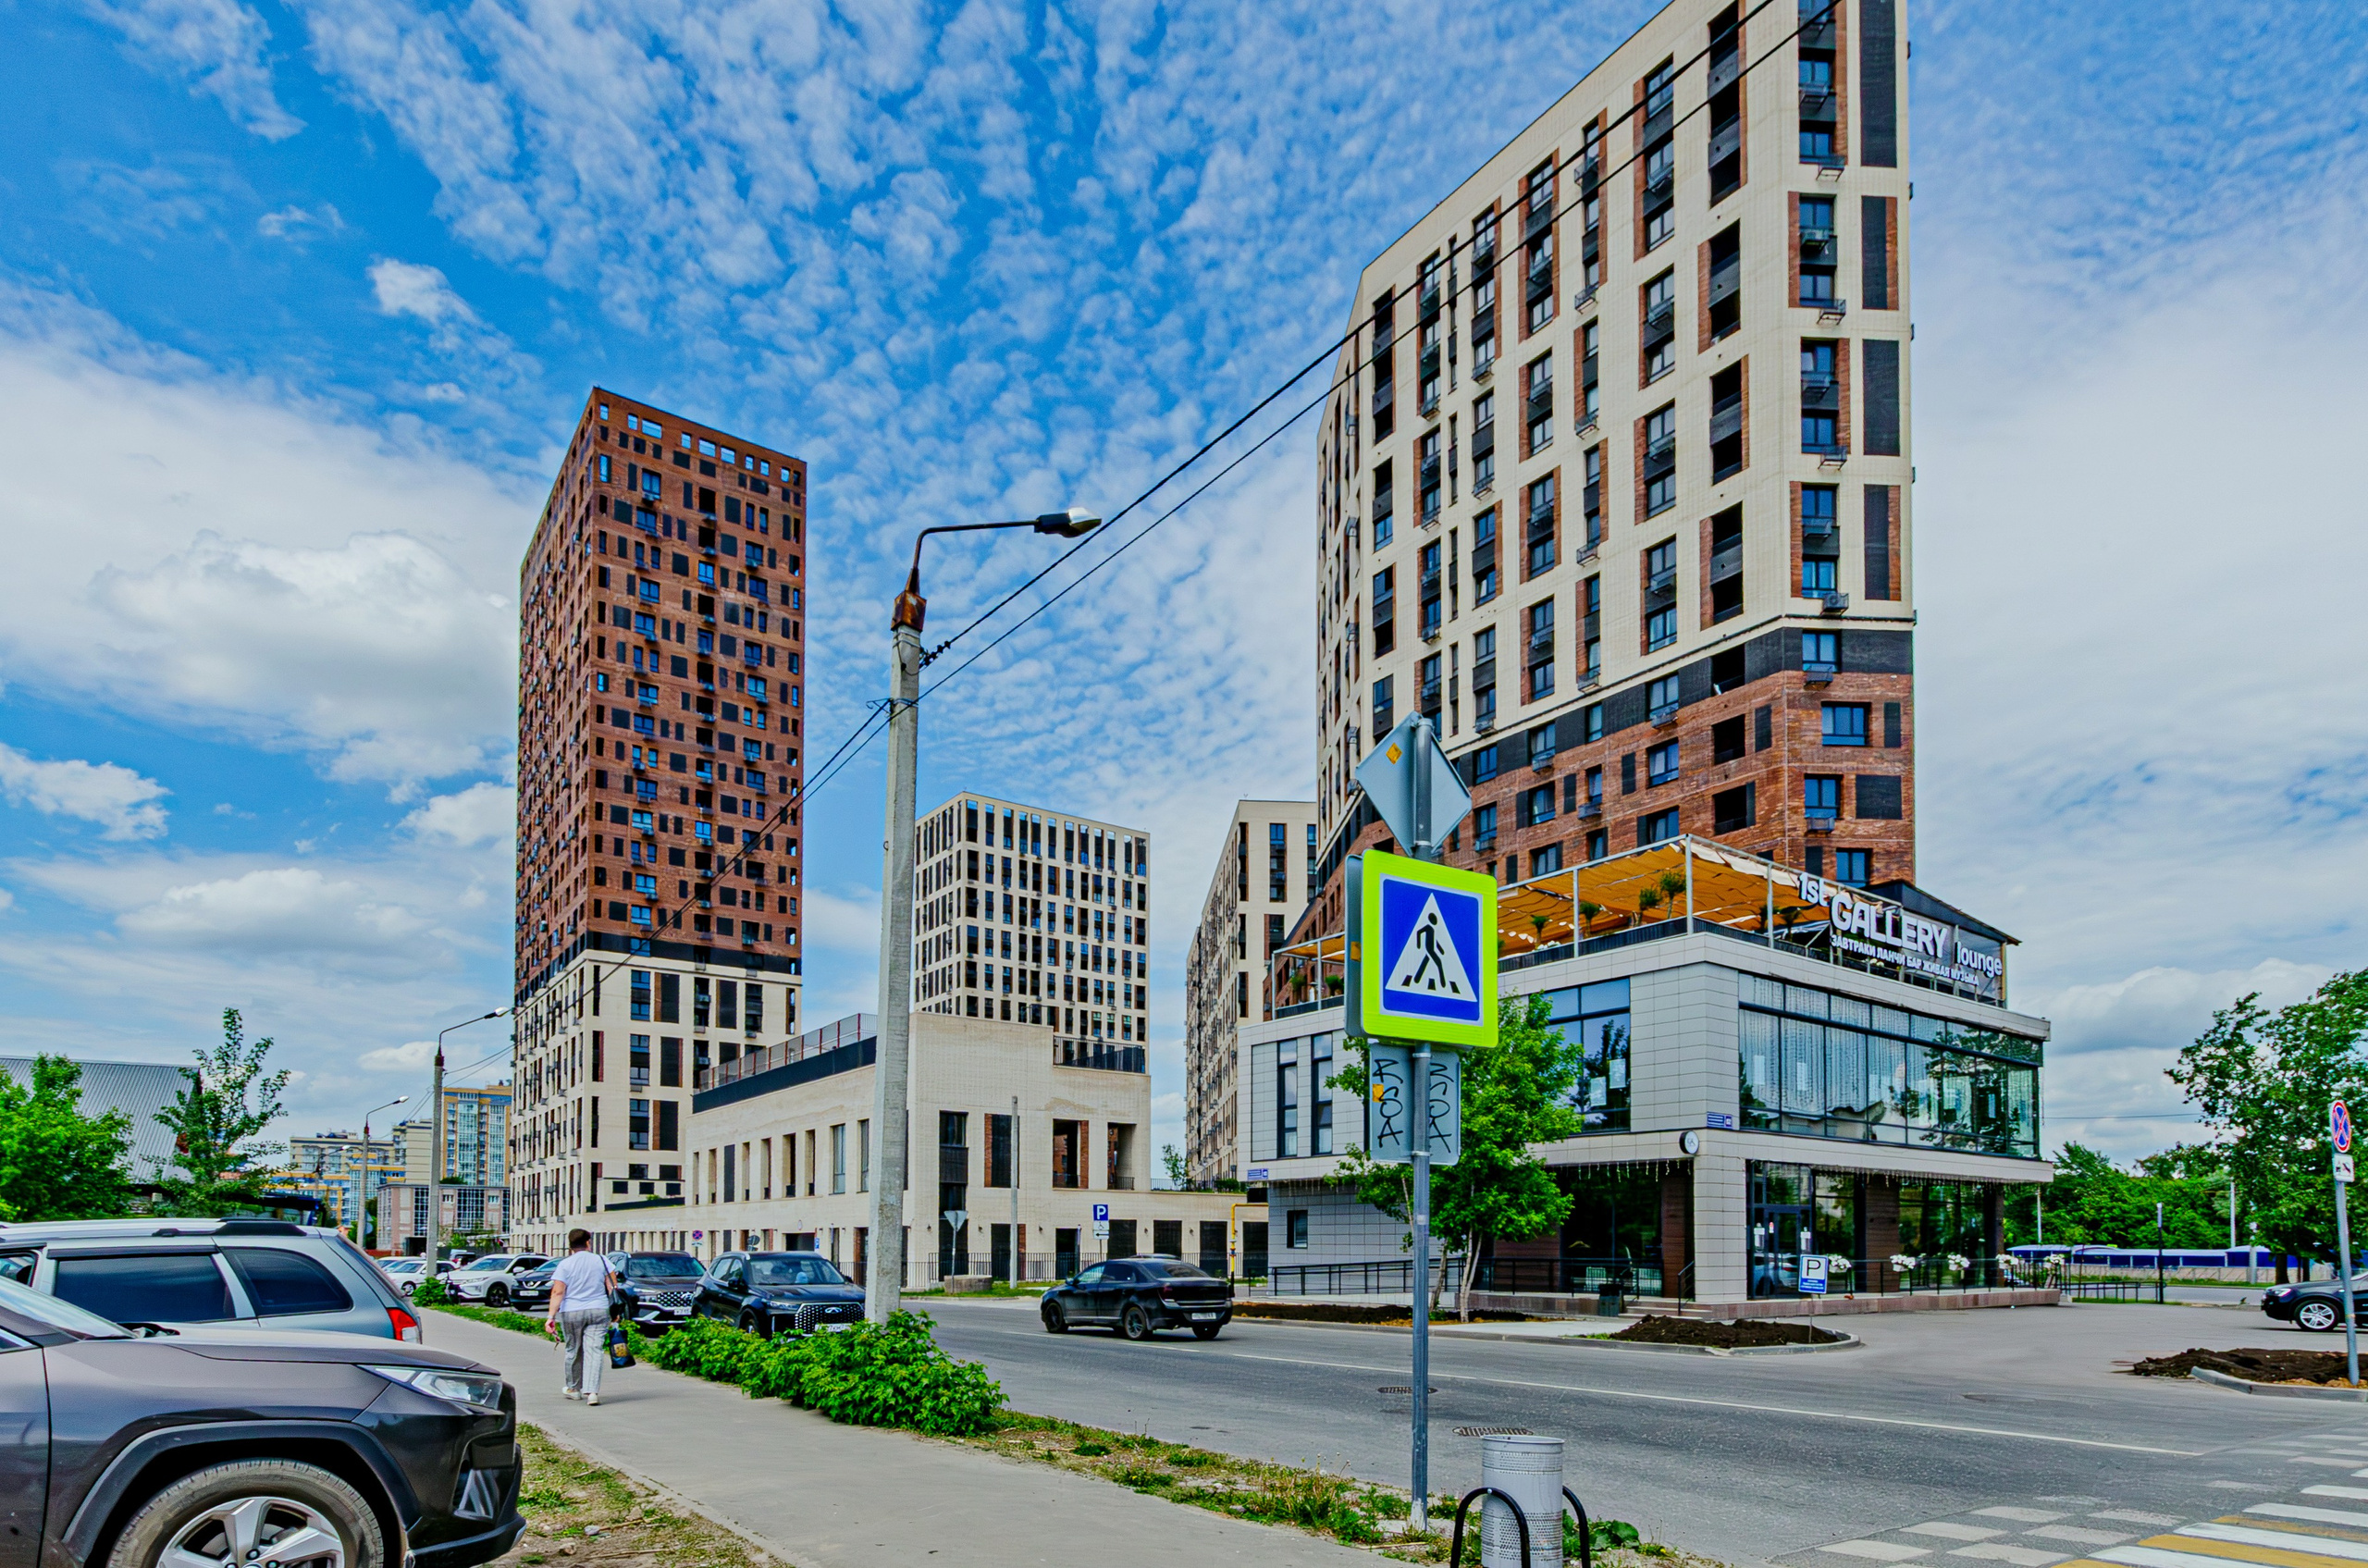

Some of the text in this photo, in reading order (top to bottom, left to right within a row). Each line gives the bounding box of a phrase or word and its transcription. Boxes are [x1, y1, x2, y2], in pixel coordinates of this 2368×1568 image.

[1799, 872, 1830, 907] 1st
[1831, 894, 2003, 978] GALLERY lounge
[1832, 934, 1876, 957] ЗАВТРАКИ
[1877, 946, 1906, 966] ЛАНЧИ
[1906, 955, 1922, 969] БАР
[1097, 1205, 1106, 1220] P
[1807, 1259, 1821, 1277] P
